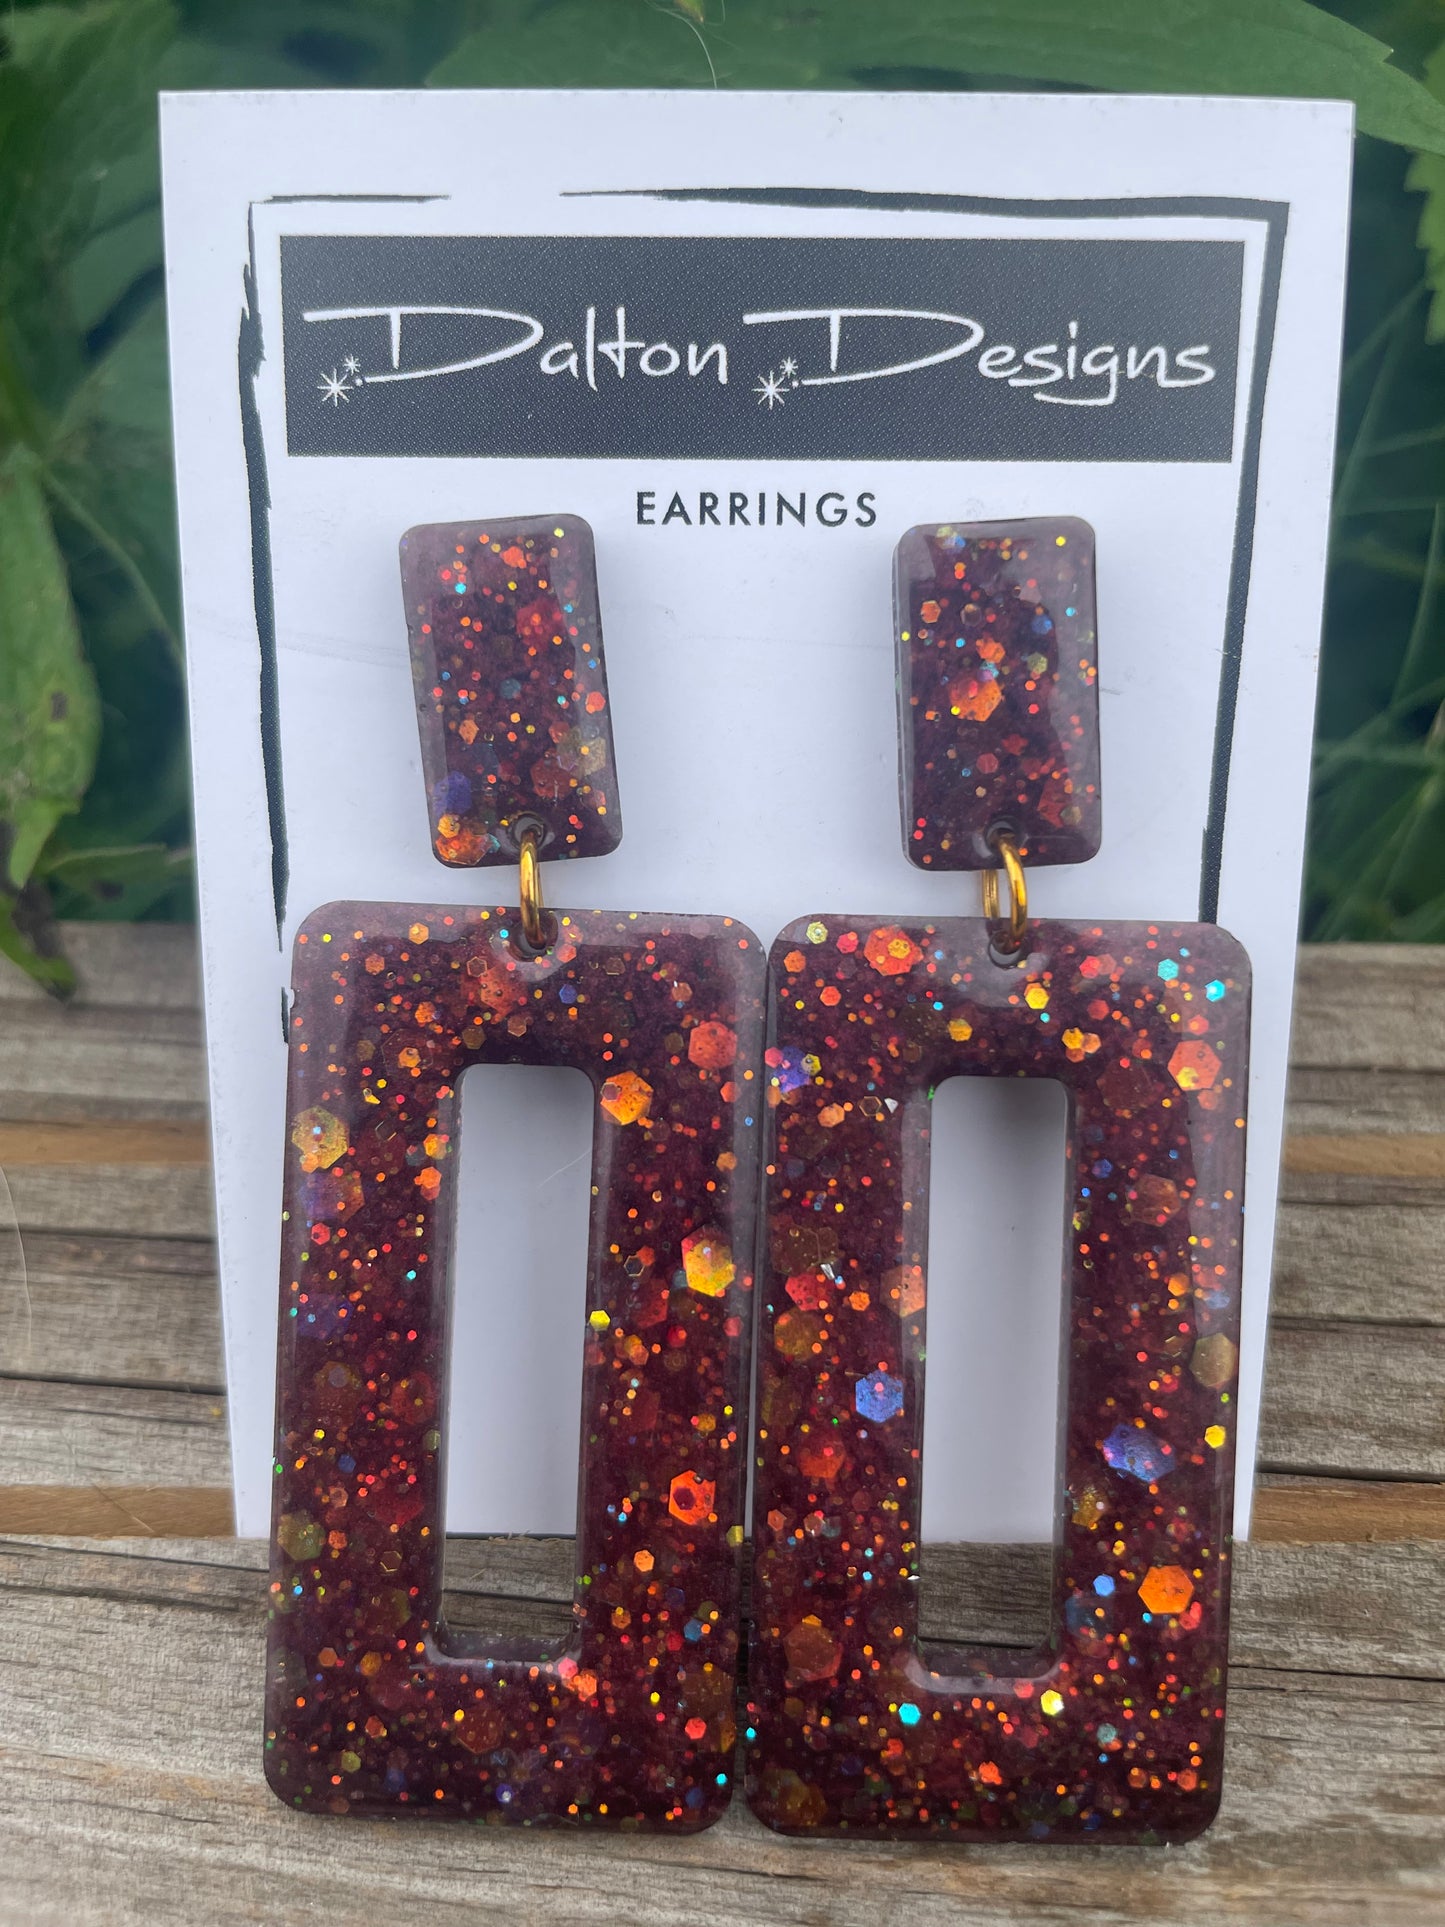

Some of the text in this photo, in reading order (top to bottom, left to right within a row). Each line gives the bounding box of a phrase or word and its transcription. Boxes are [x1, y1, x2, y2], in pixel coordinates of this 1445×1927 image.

[302, 305, 1217, 407] Dalton Designs
[636, 491, 878, 528] EARRINGS
